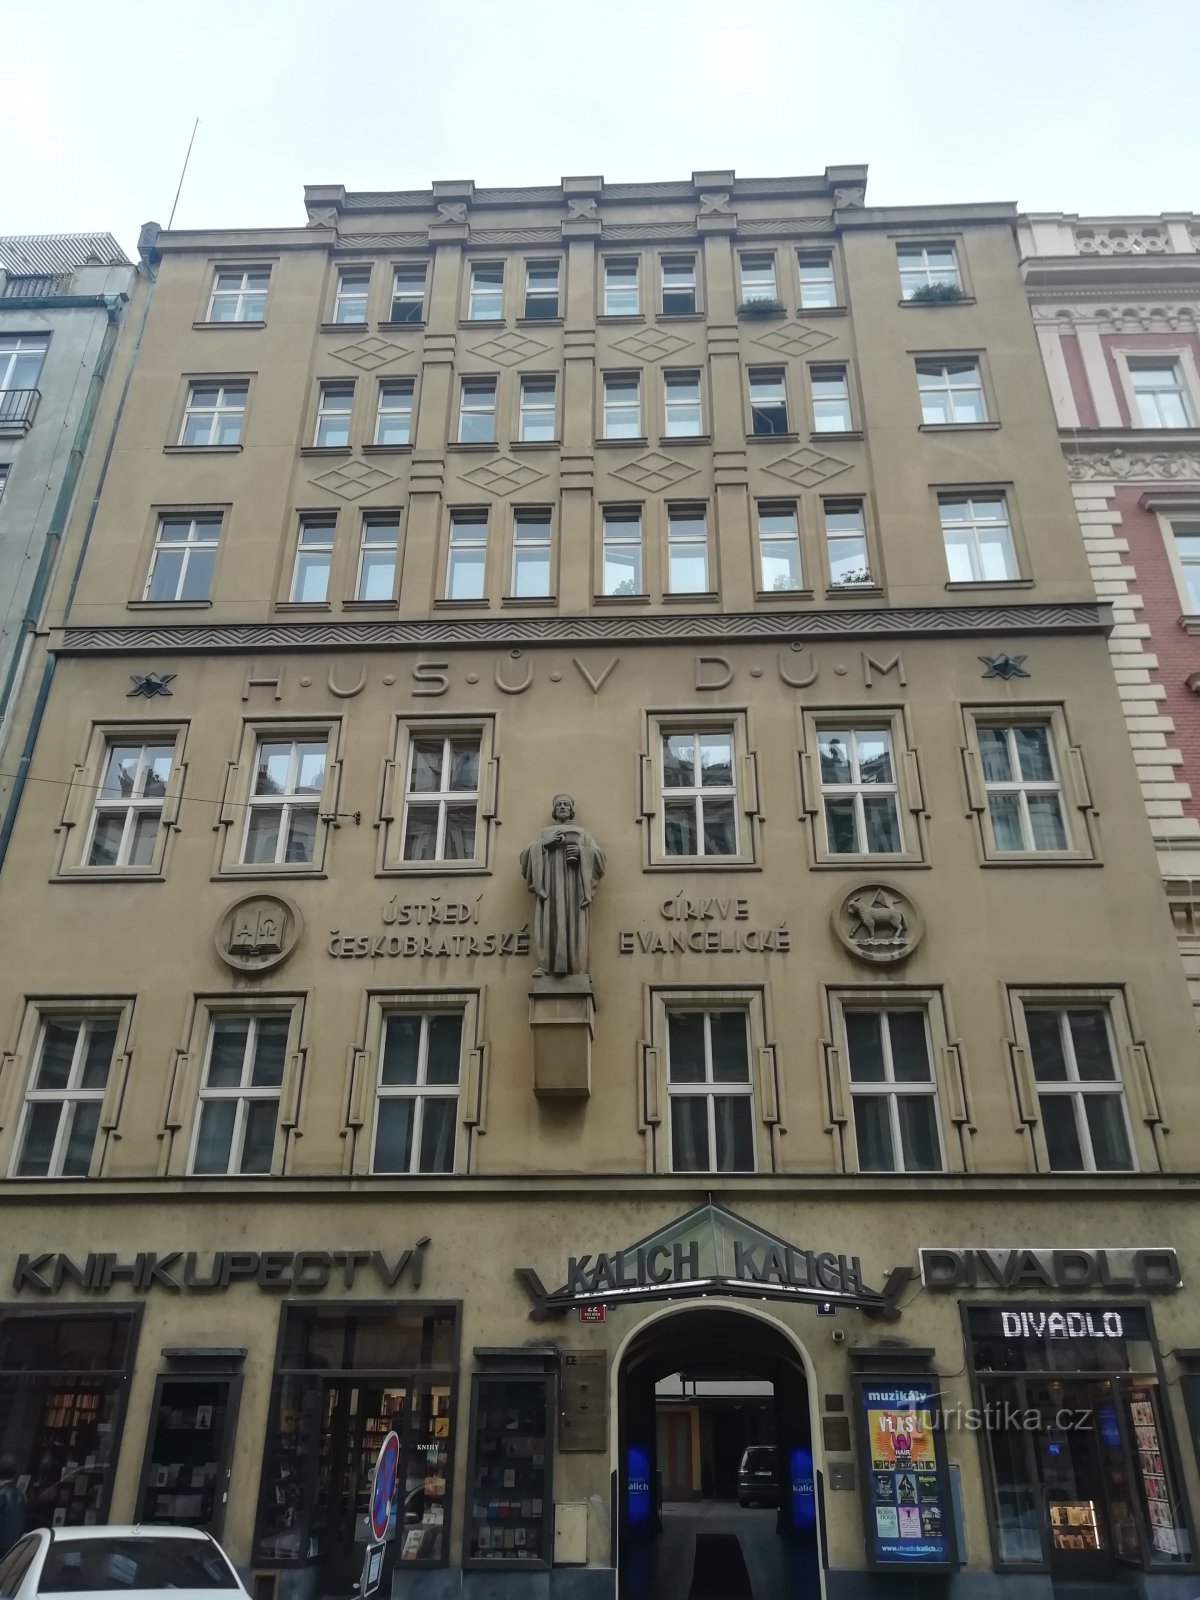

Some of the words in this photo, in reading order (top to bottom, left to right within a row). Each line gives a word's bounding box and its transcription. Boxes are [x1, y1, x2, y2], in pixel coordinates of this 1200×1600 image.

[382, 894, 484, 925] ÚSTŘEDÍ
[660, 890, 749, 921] CÍRKVE
[328, 924, 530, 958] ČESKOBRATRSKÉ
[12, 1236, 431, 1291] KNIHKUPECTVÍ
[567, 1241, 699, 1292] KALICH
[733, 1241, 863, 1292] KALICH
[921, 1248, 1182, 1288] DIVADLO
[1001, 1312, 1124, 1338] DIVADLO
[628, 1482, 649, 1491] alich
[792, 1483, 814, 1492] kalic
